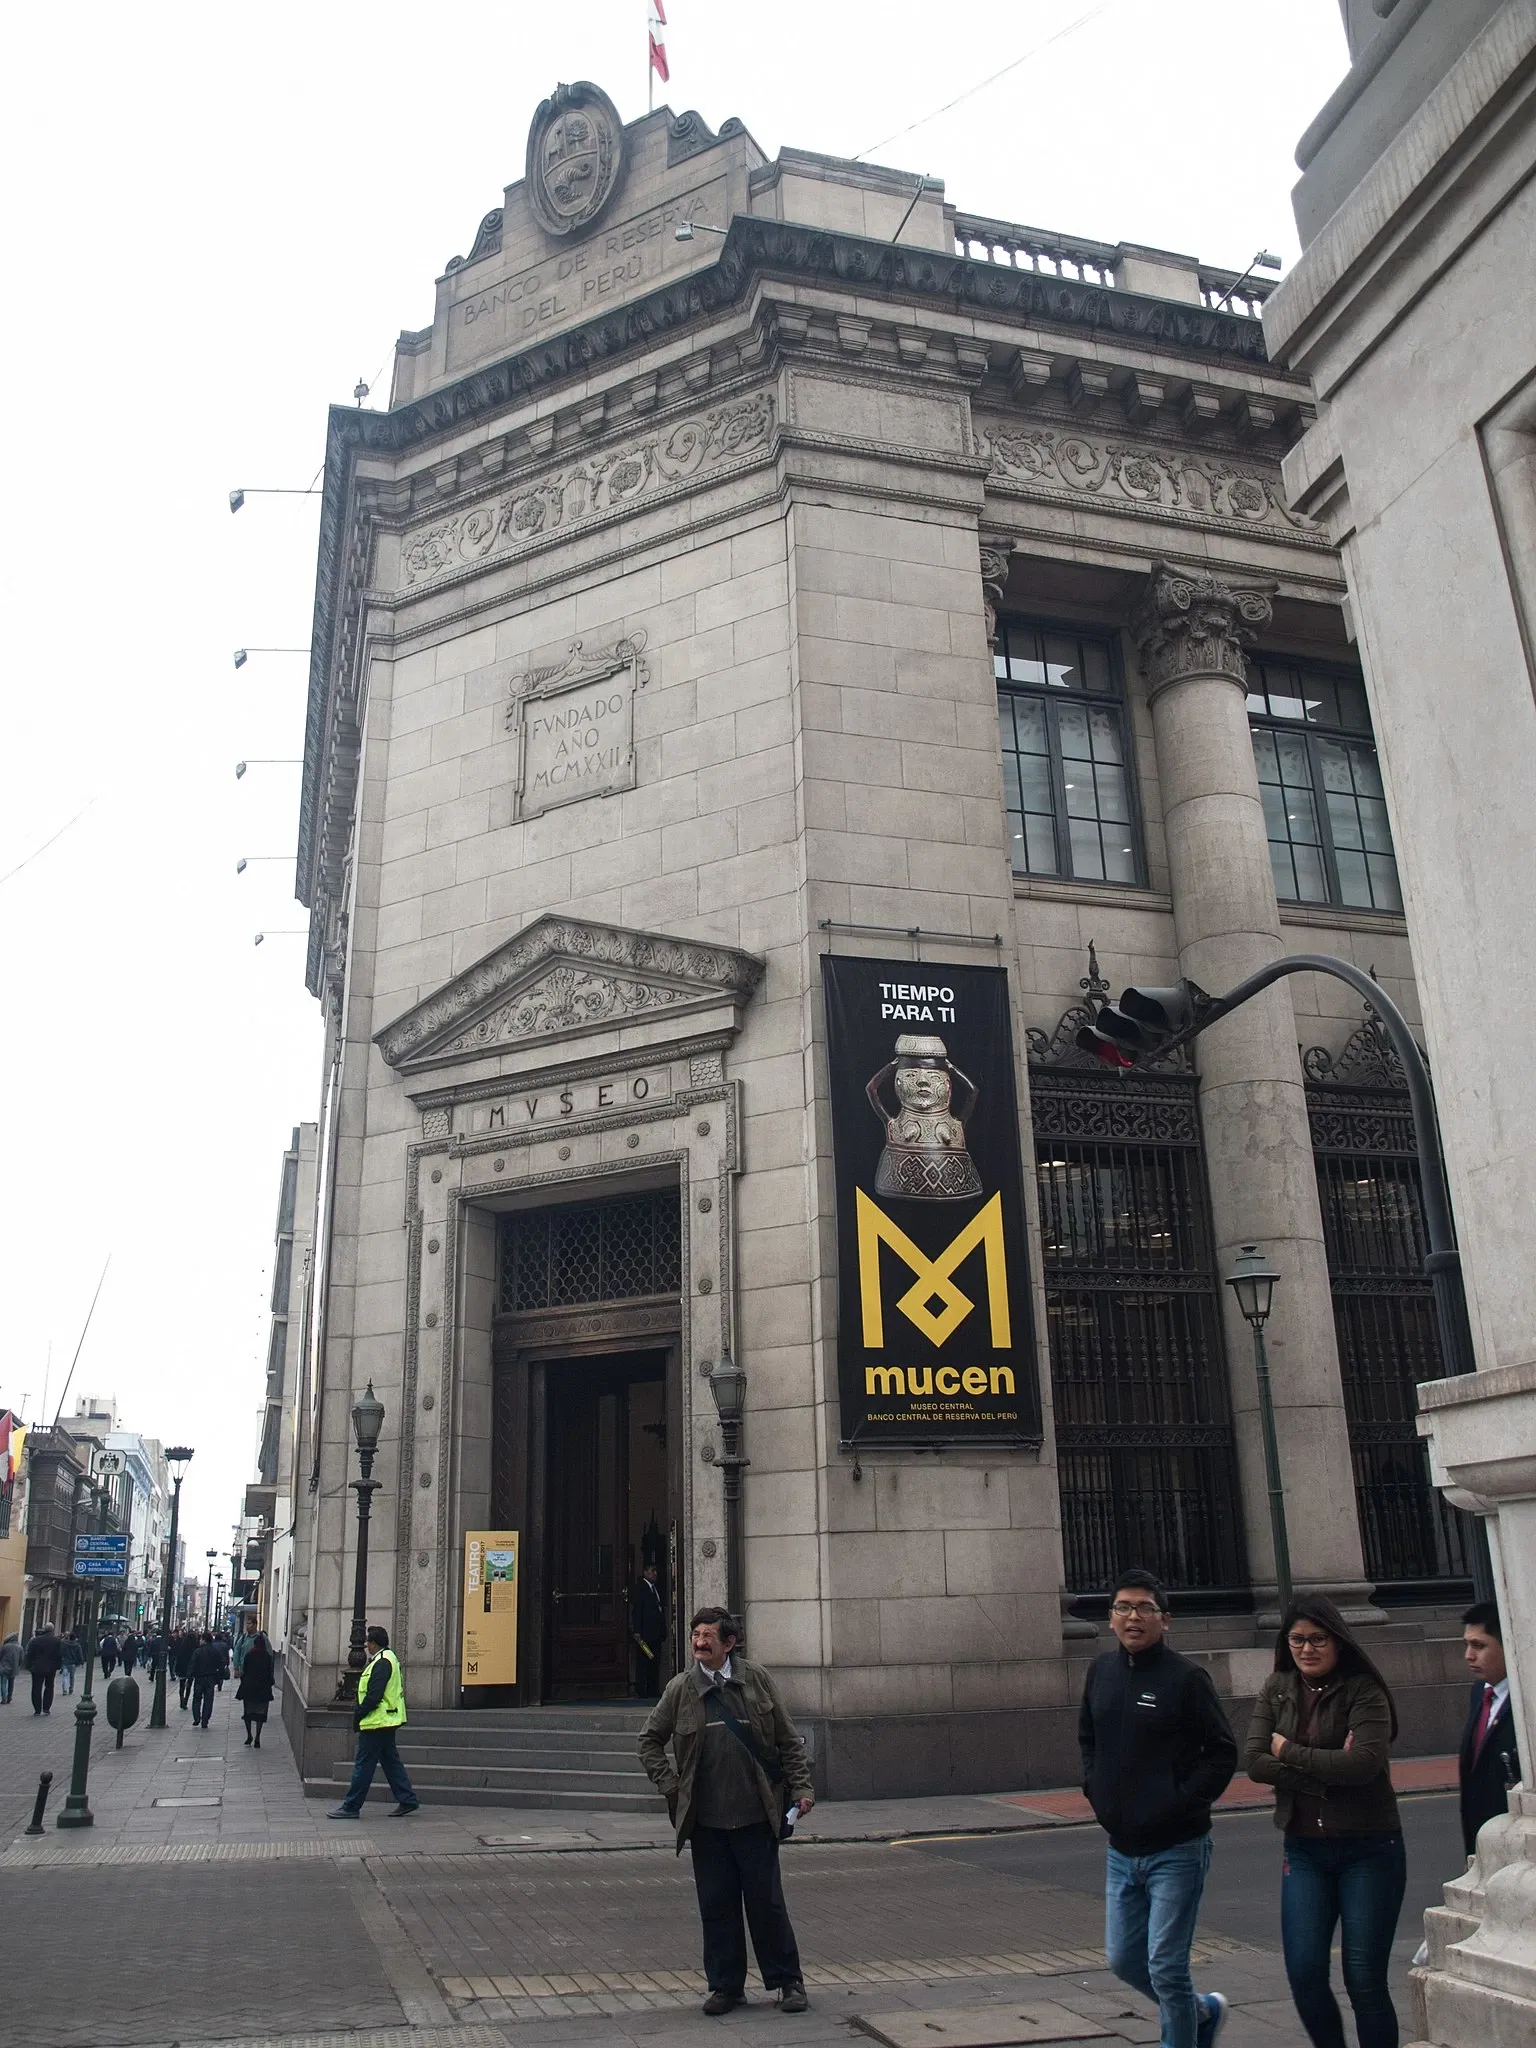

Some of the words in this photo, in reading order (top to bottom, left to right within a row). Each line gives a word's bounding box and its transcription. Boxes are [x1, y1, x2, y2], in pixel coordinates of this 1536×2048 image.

[464, 275, 541, 326] BANCO
[556, 249, 588, 281] DE
[604, 197, 708, 258] RESERVA
[521, 296, 566, 329] DEL
[532, 694, 623, 740] FVNDADO
[555, 728, 600, 759] AÑO
[532, 746, 620, 791] MCMXXII
[879, 983, 955, 1003] TIEMPO
[881, 1004, 934, 1022] PARA
[937, 1007, 956, 1023] TI
[489, 1077, 649, 1129] MVSEO
[865, 1366, 1016, 1395] mucen
[867, 1413, 894, 1421] BANCO
[896, 1413, 931, 1421] CENTRAL
[910, 1403, 938, 1411] MUSEO
[468, 1541, 480, 1594] TEATRO
